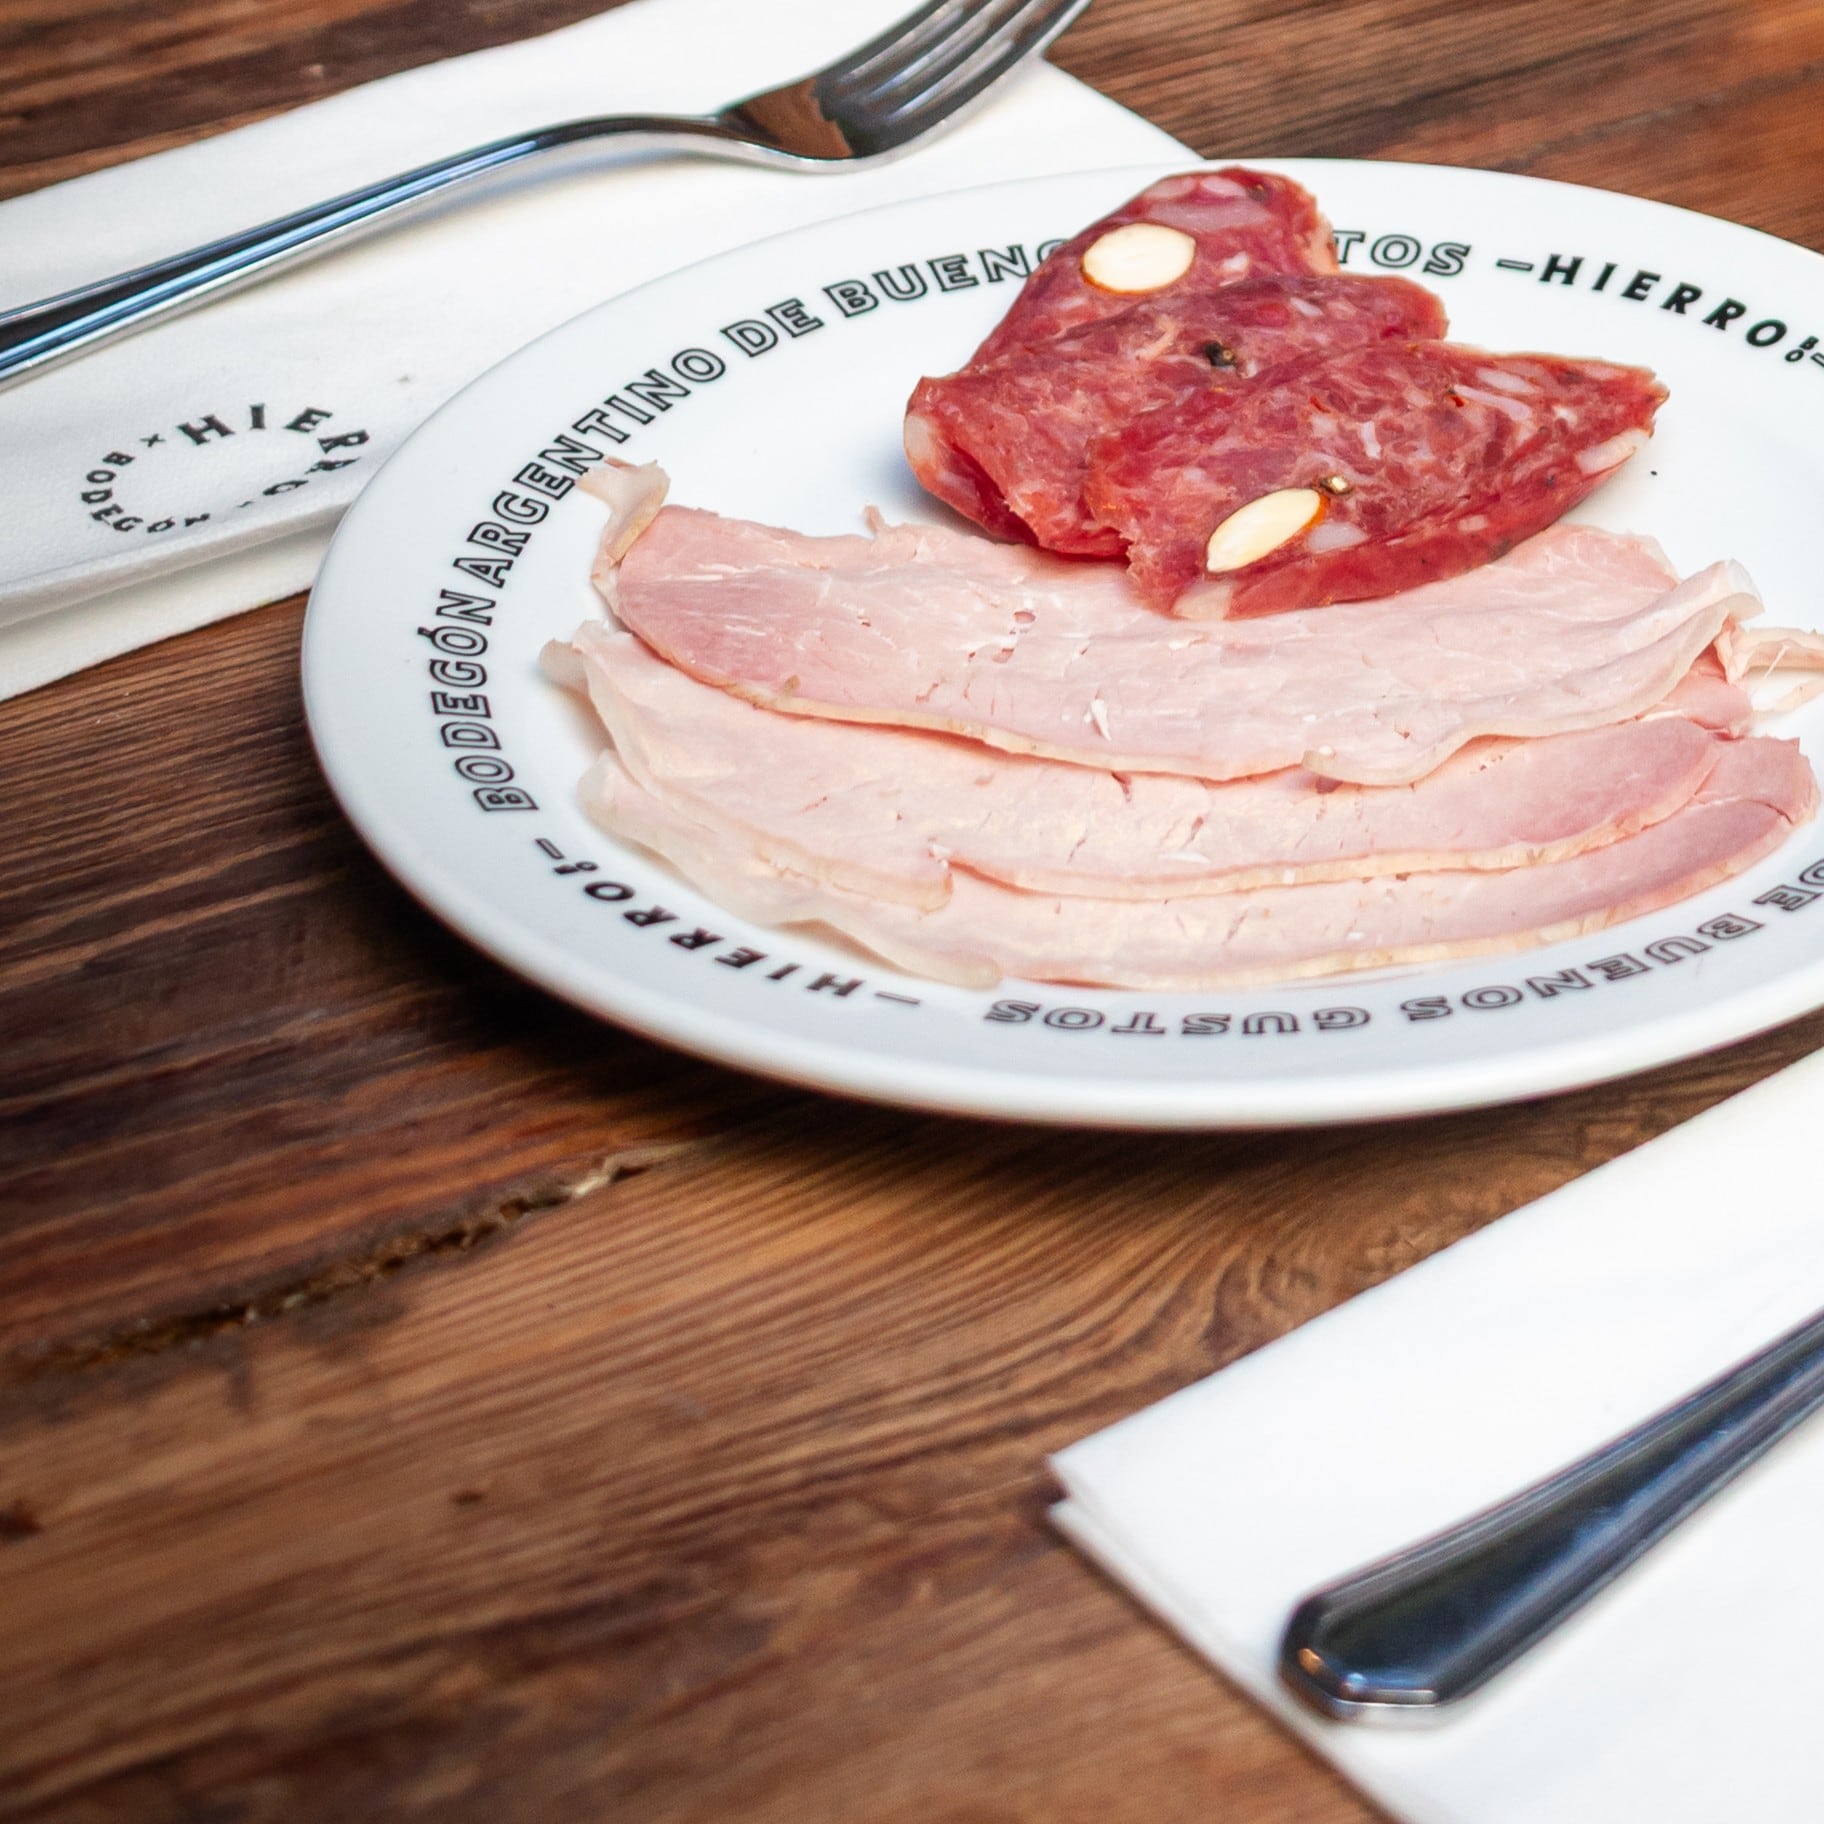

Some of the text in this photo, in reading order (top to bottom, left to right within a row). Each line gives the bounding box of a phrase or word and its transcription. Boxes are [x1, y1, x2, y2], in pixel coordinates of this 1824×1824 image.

[821, 238, 1069, 318] BUEN
[1332, 229, 1472, 277] TOS
[719, 297, 825, 359] DE
[452, 348, 727, 590] ARGENTINO
[416, 588, 540, 813] BODEGÓN
[1399, 912, 1766, 1023] BUENOS
[983, 999, 1373, 1037] GUSTOS
